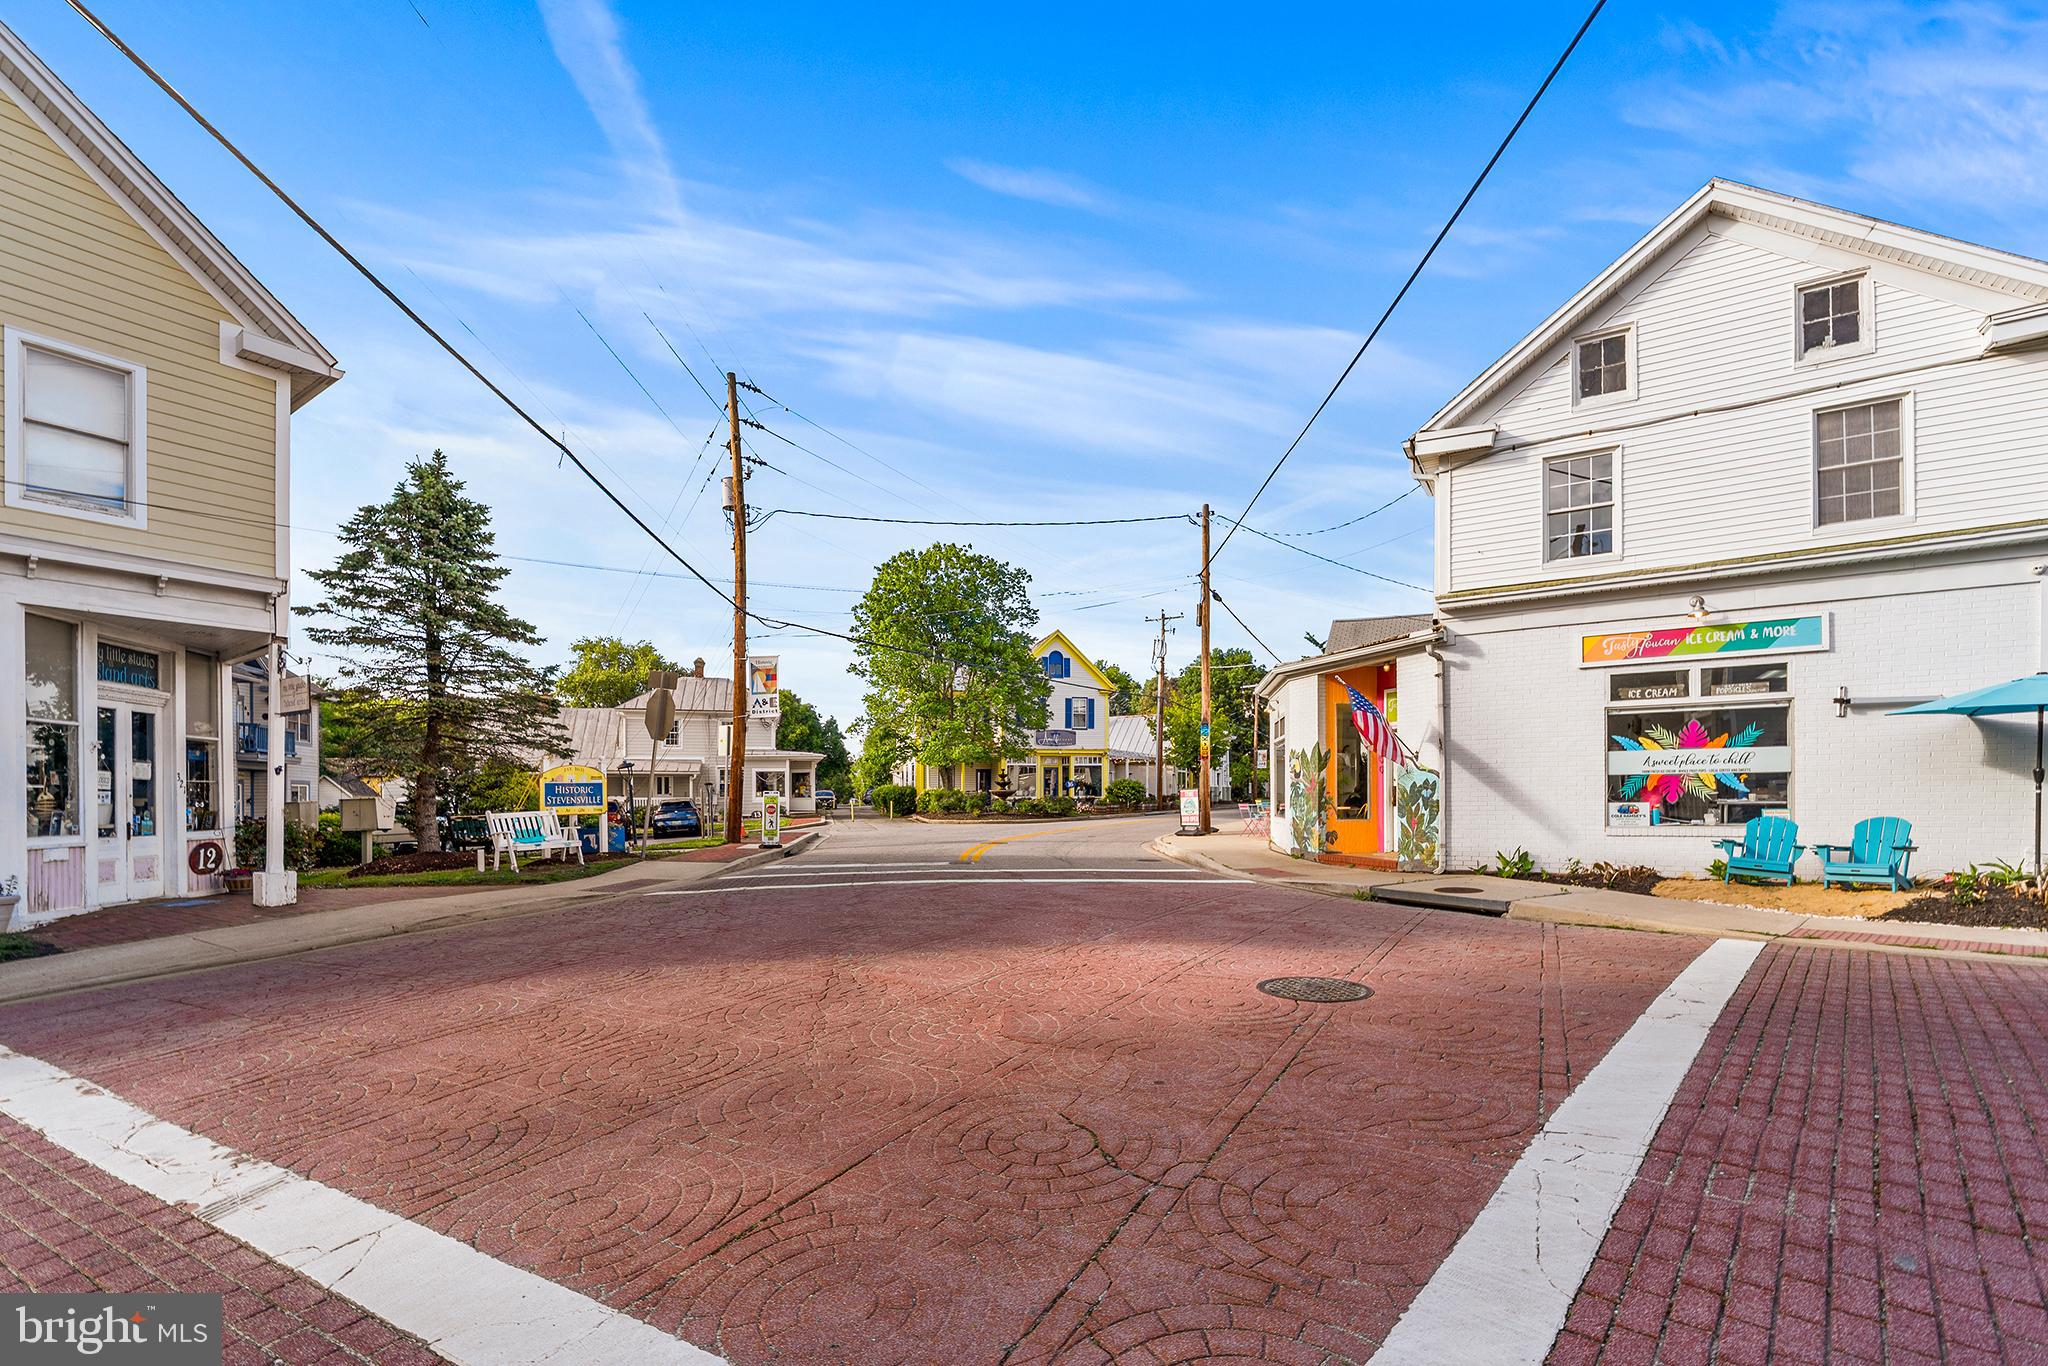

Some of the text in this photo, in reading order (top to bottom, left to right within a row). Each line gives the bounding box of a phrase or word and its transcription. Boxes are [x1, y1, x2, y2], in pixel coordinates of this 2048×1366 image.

[1602, 634, 1644, 658] Tasty
[1639, 632, 1681, 657] Toucan
[1706, 628, 1746, 643] CREAM
[1750, 627, 1759, 639] &
[1762, 624, 1798, 639] MORE
[106, 645, 126, 663] little
[128, 652, 155, 669] studio
[97, 662, 155, 689] sland arts
[1628, 687, 1678, 698] ICE CREAM
[1651, 754, 1682, 768] sweet
[1678, 752, 1706, 768] place
[1707, 753, 1720, 765] to
[1722, 751, 1756, 765] chill
[176, 772, 187, 794] 321
[555, 785, 595, 795] HISTORIC
[546, 795, 601, 805] STEVENSVILLE
[198, 847, 217, 870] 12
